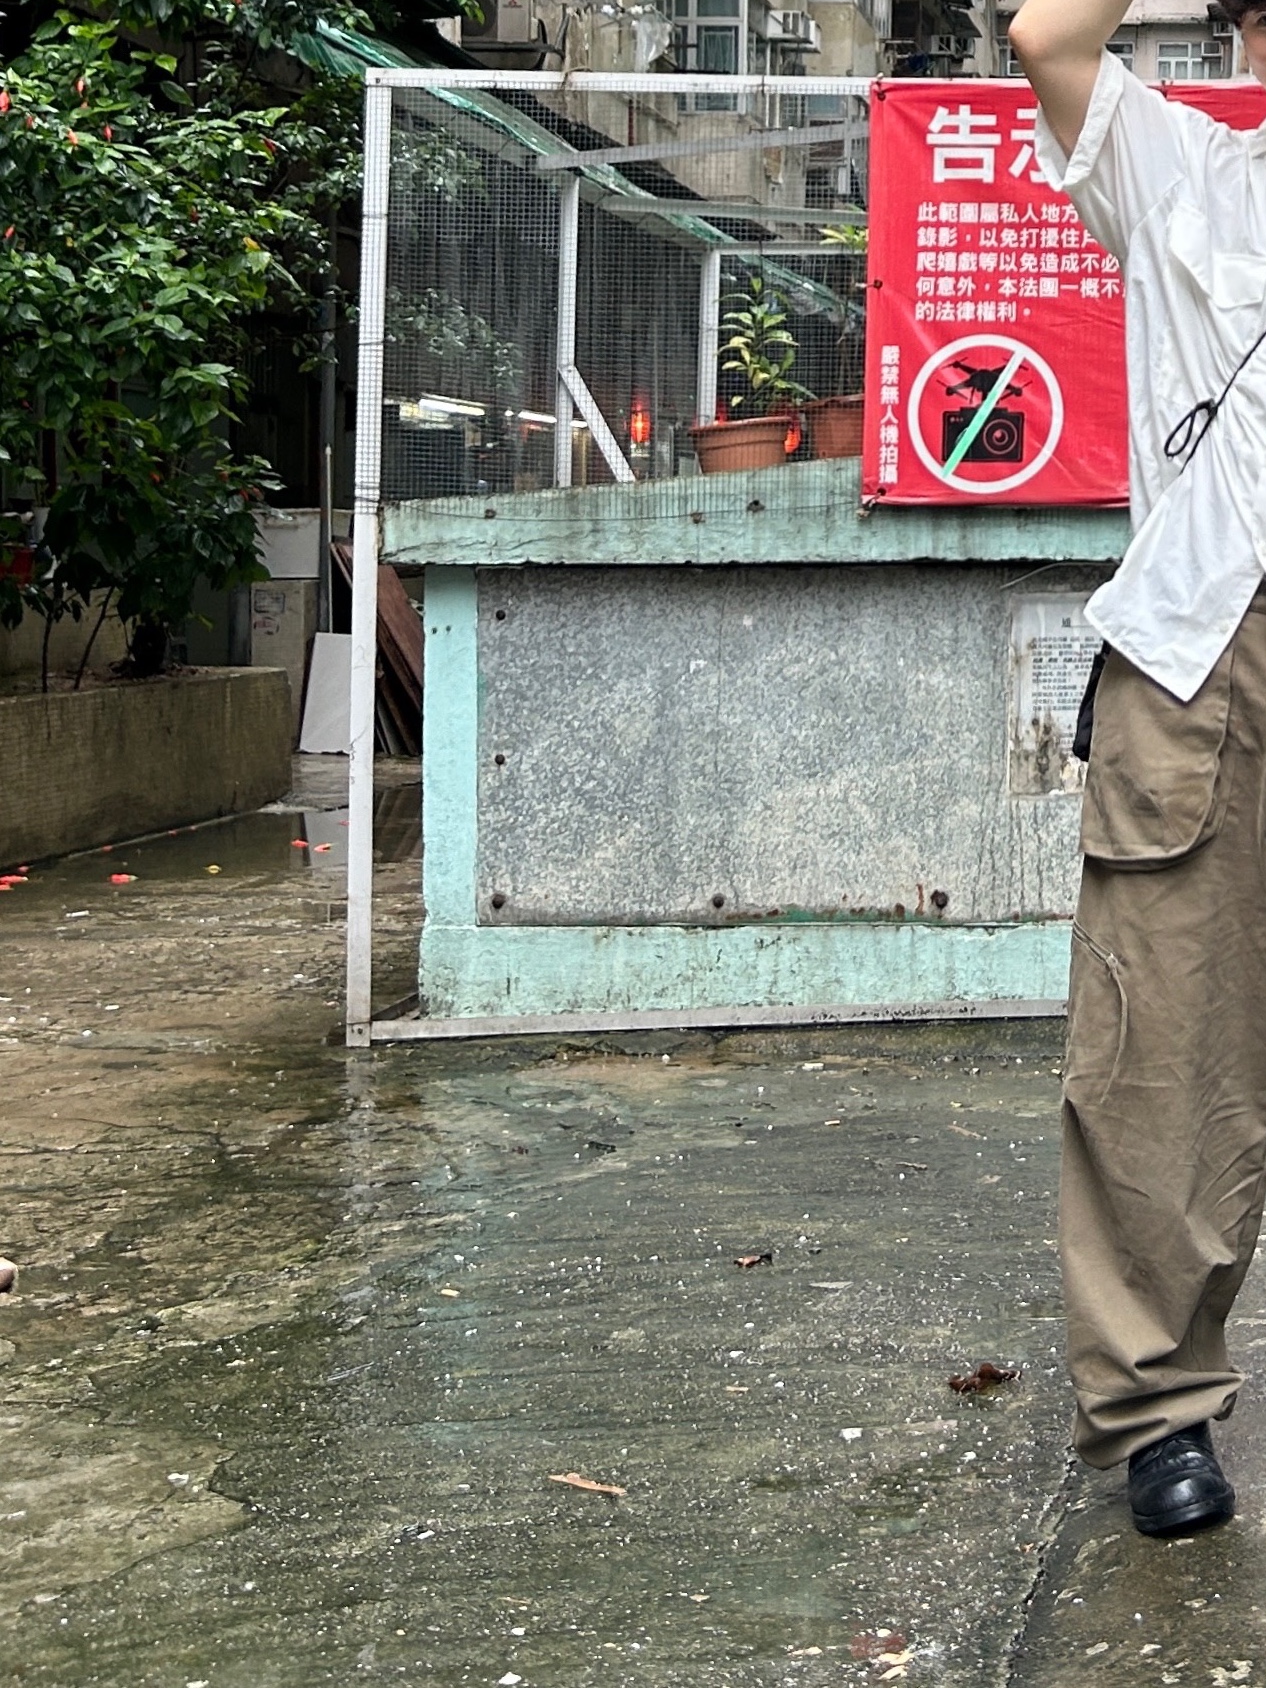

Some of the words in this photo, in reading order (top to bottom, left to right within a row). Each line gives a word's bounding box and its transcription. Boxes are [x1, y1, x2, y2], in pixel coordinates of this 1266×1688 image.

[917, 202, 1079, 223] 此範圍屬私人地方
[915, 276, 1125, 298] 何意外，本法團一概不
